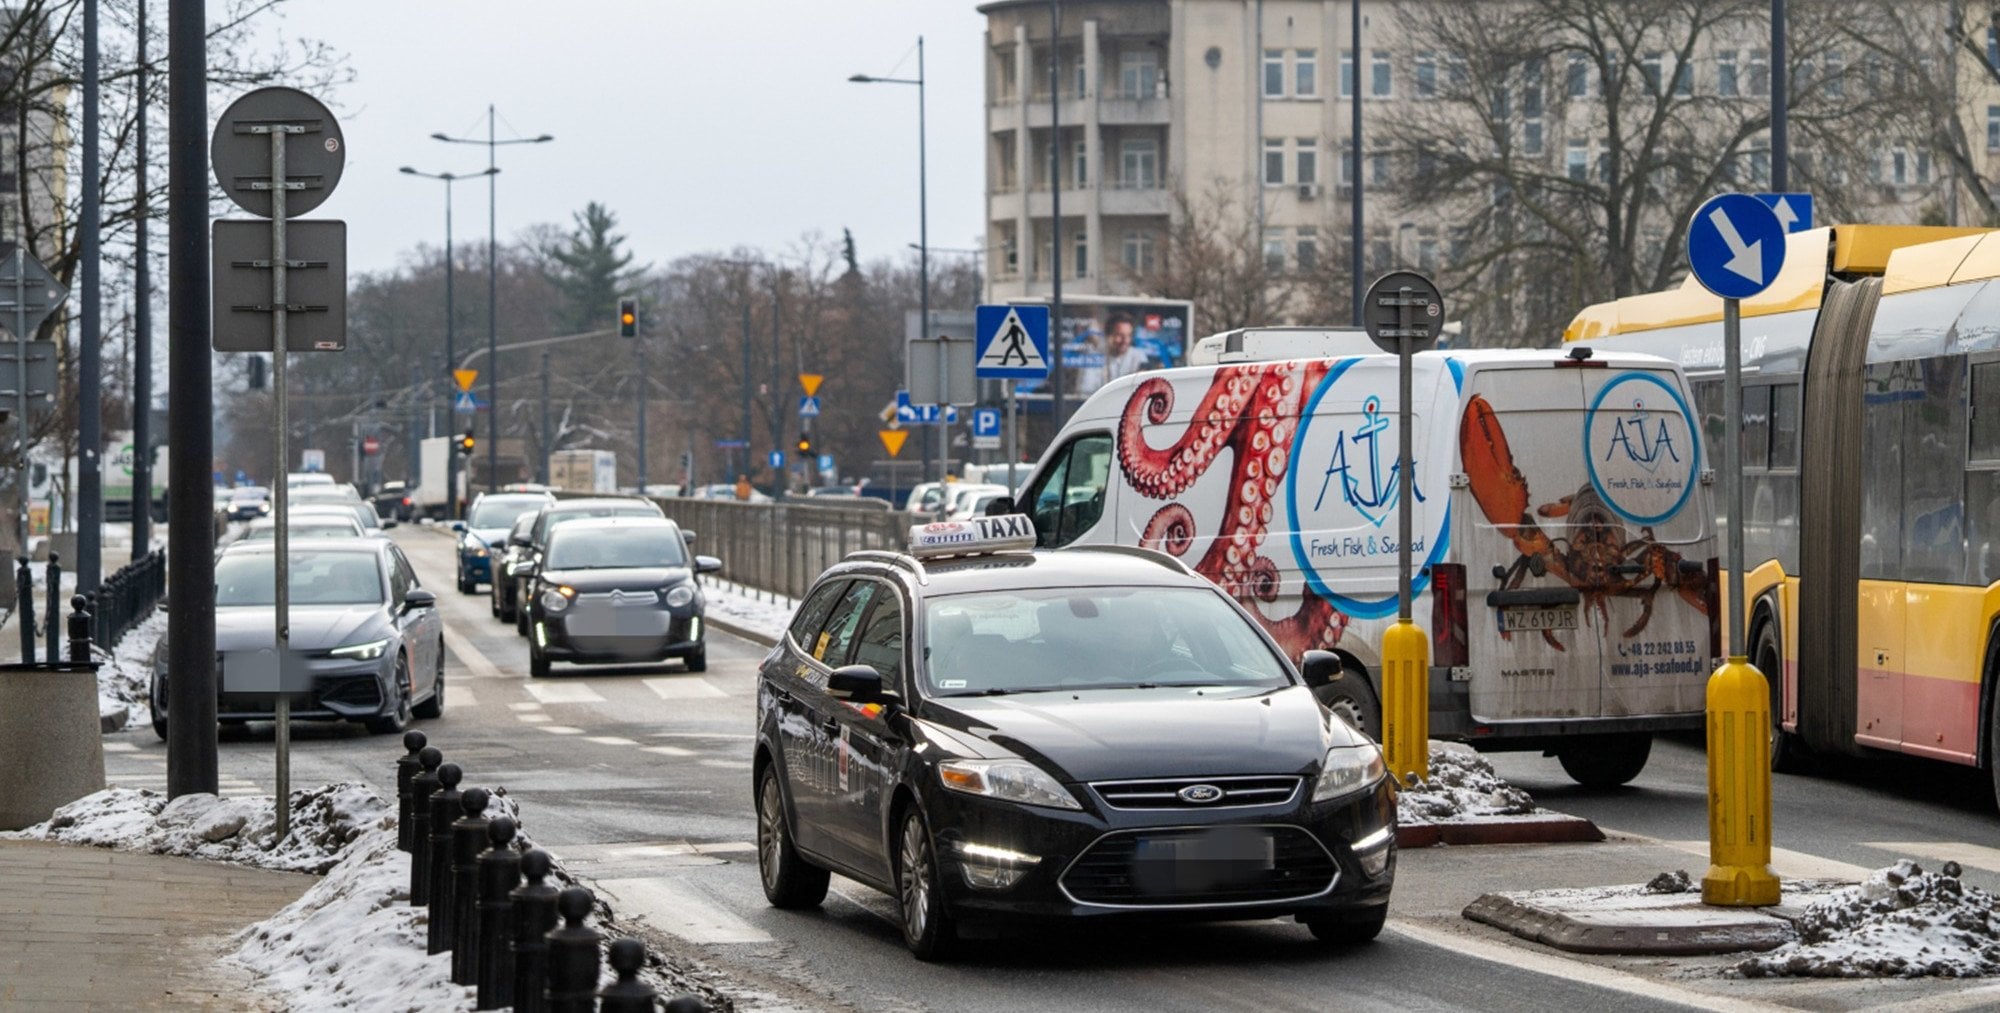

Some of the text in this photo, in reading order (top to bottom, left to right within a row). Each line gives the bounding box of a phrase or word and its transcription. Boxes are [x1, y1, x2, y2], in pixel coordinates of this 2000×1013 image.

[979, 412, 996, 433] P
[1606, 416, 1680, 463] AJA
[1607, 477, 1630, 490] Fresh
[1630, 477, 1646, 490] Fish
[1655, 478, 1681, 493] Seafood
[975, 516, 1030, 539] TAXI
[1311, 538, 1341, 557] Fresh
[1343, 537, 1366, 557] Fish
[1367, 535, 1378, 555] &
[1507, 612, 1526, 628] WZ
[1644, 643, 1655, 655] 22
[1657, 642, 1672, 655] 242
[1685, 641, 1696, 653] 55
[1501, 668, 1556, 677] MASTER
[1611, 656, 1703, 678] www.aja-seafood.pl
[1192, 788, 1212, 799] Ford
